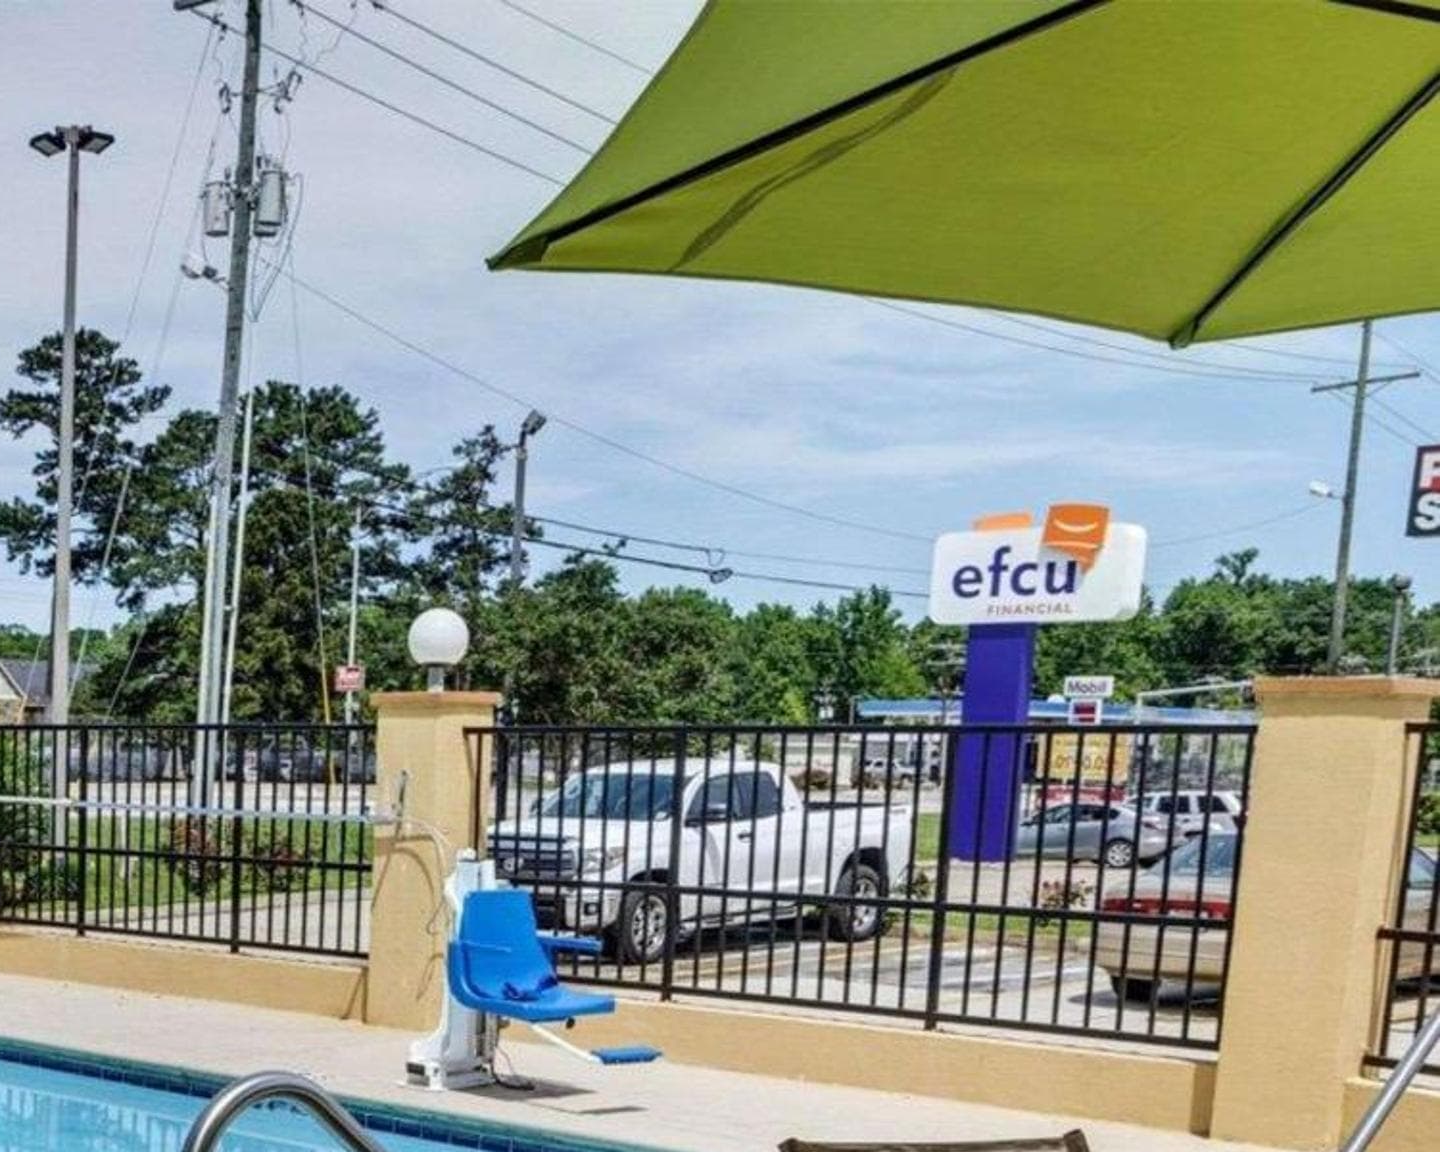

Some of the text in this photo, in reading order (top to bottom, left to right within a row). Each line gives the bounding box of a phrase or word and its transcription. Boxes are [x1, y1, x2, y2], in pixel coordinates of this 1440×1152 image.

[953, 545, 1077, 598] efcu
[988, 603, 1073, 615] FINANCIAL
[1068, 680, 1107, 693] Mobil
